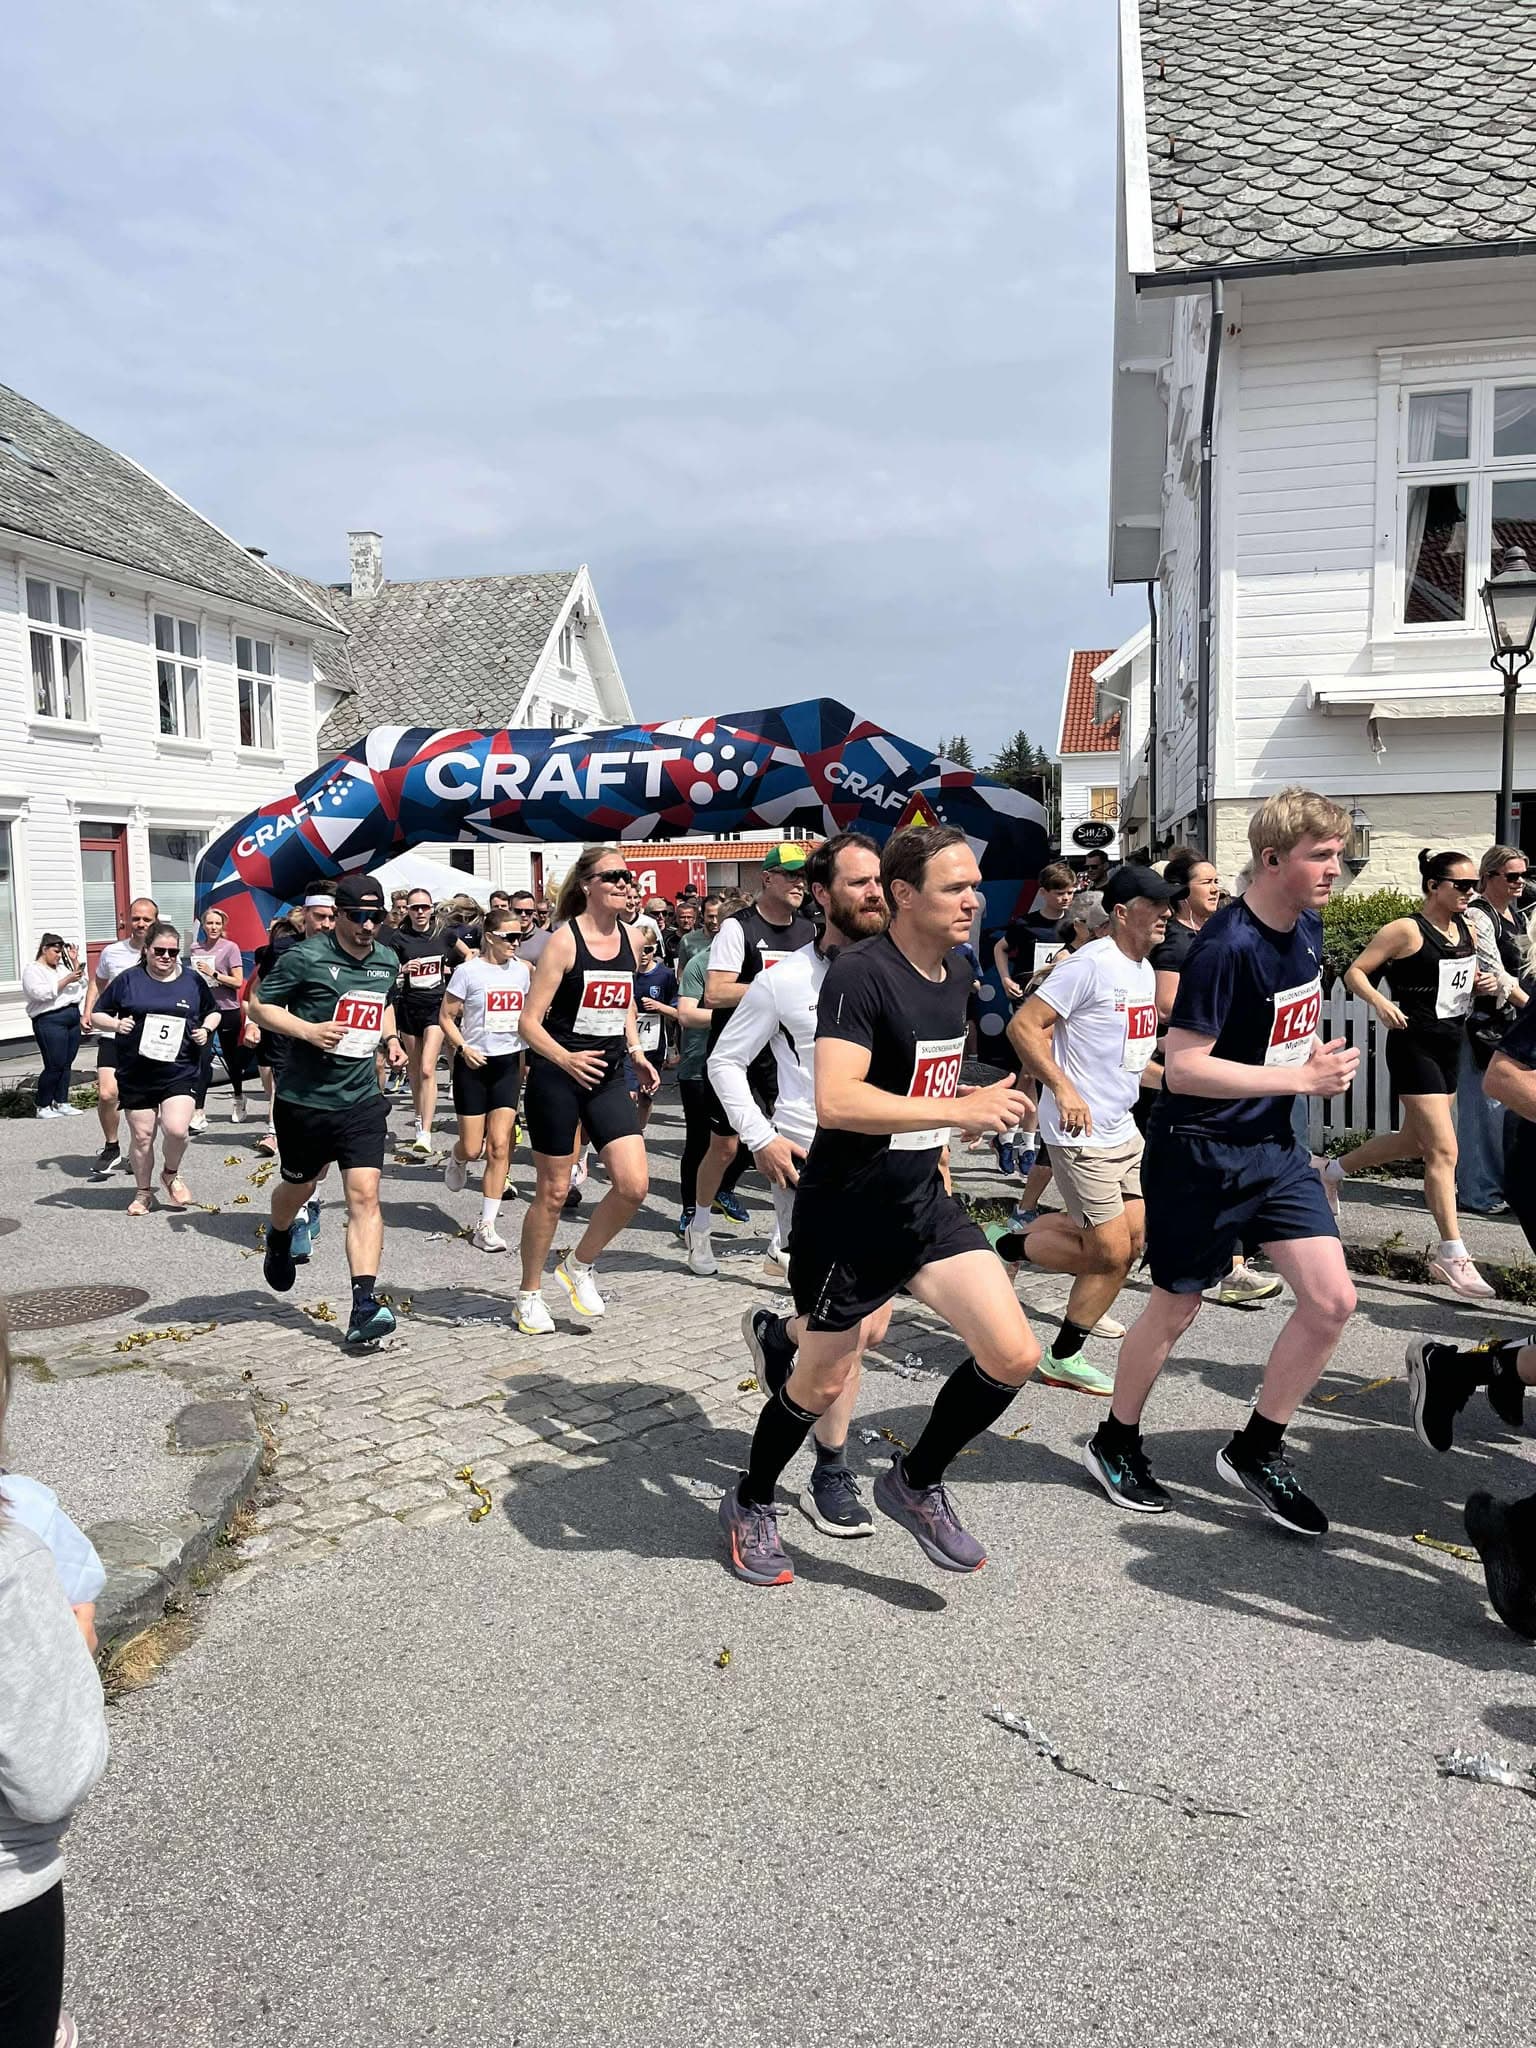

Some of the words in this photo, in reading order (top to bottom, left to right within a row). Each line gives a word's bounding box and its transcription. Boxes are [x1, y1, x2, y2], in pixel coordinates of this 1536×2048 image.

[425, 748, 682, 800] CRAFT
[824, 762, 911, 809] CRAF
[237, 790, 324, 857] CRAFT
[1451, 970, 1468, 989] 45
[492, 992, 519, 1010] 212
[593, 984, 626, 1007] 154
[346, 1003, 378, 1028] 173
[1134, 1009, 1155, 1036] 179
[1283, 998, 1318, 1039] 142
[160, 1025, 170, 1039] 5
[924, 1059, 958, 1098] 198
